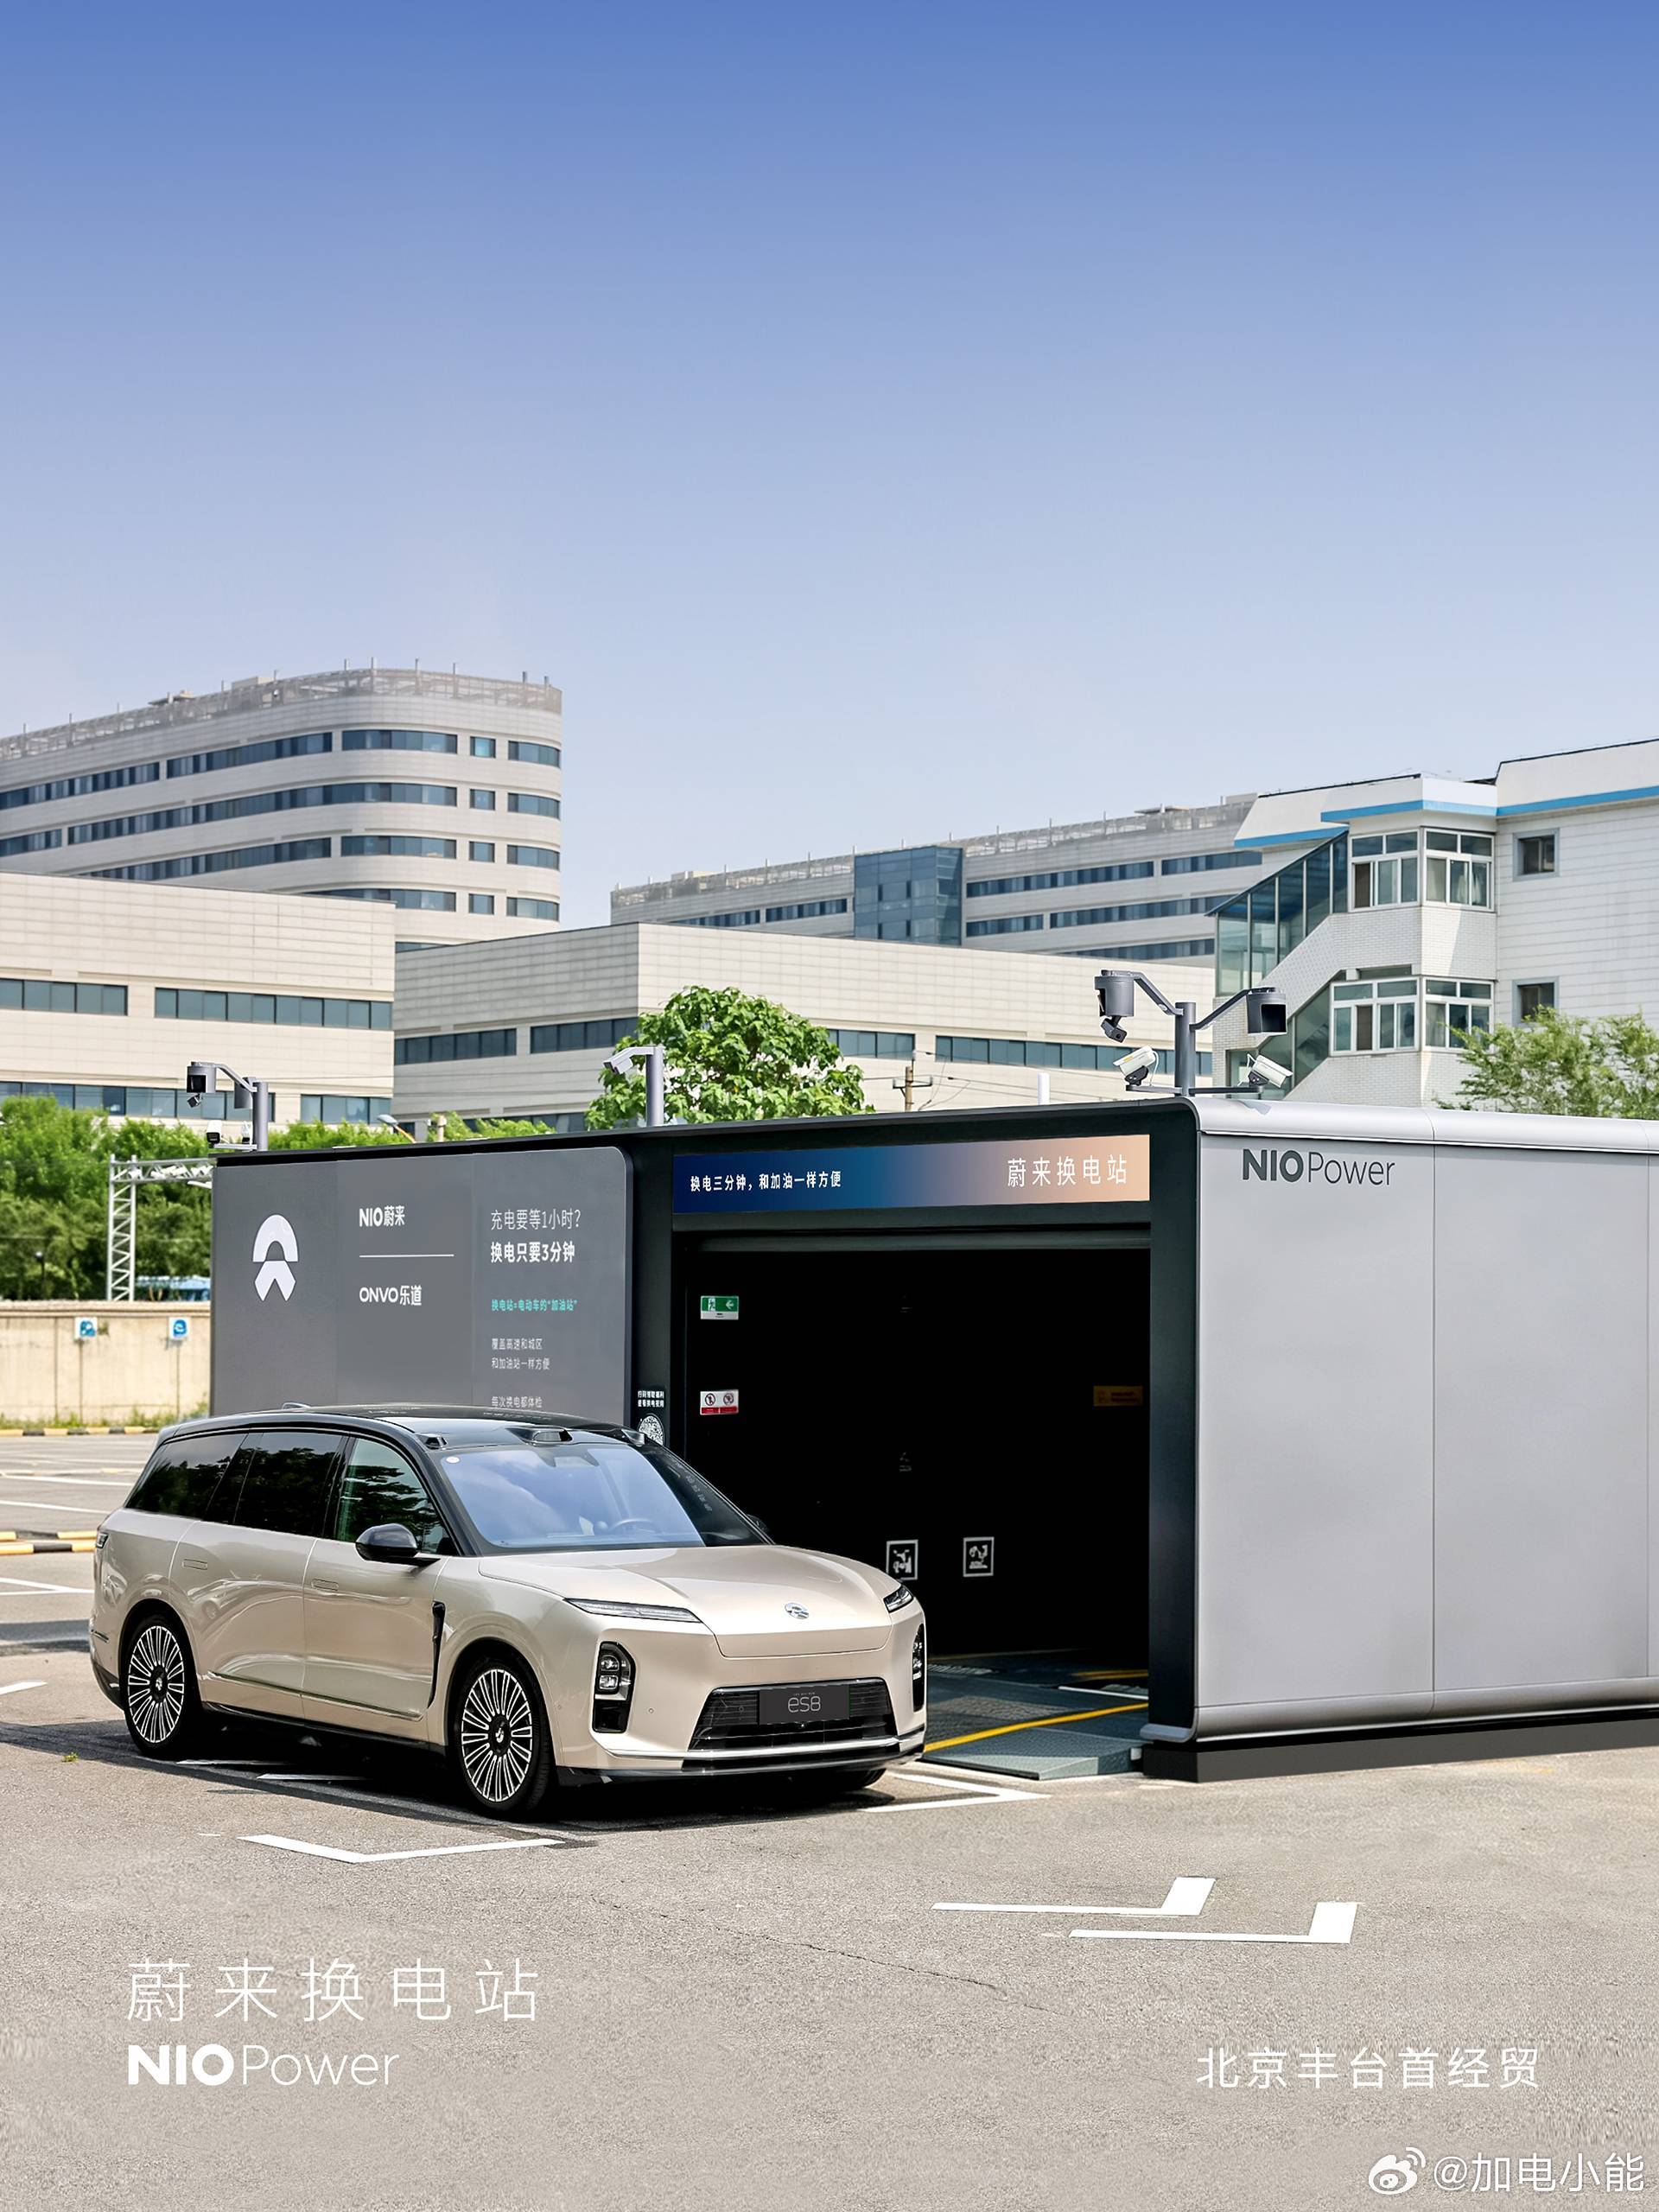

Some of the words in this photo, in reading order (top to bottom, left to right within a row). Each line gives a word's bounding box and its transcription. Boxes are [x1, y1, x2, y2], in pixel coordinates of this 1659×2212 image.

[1007, 1154, 1128, 1188] 蔚来换电站
[690, 1170, 842, 1192] 换电三分钟，和加油一样方便
[491, 1241, 575, 1264] 换电只要3分钟
[491, 1338, 543, 1350] 覆盖高速和城区
[491, 1357, 550, 1370] 和加油站一样方便
[491, 1396, 543, 1408] 每次换电都体检
